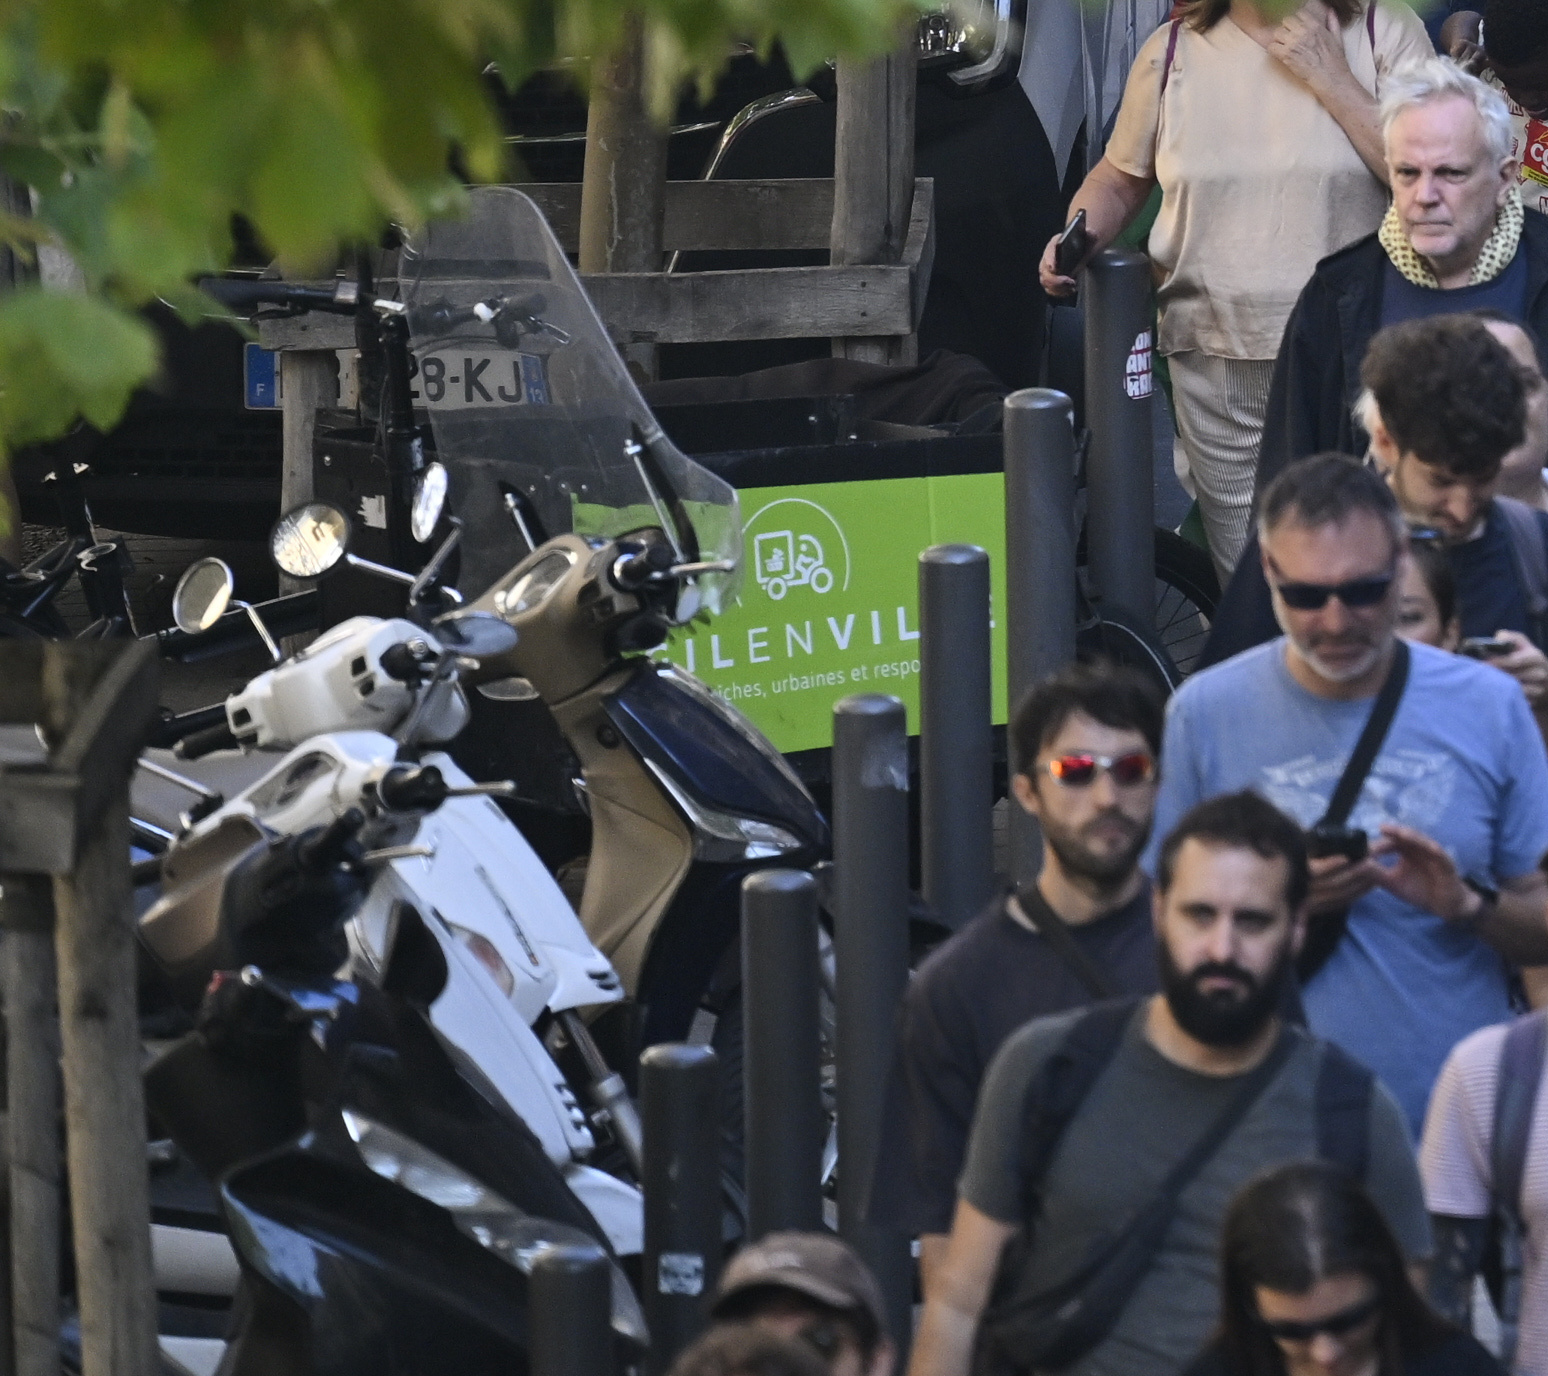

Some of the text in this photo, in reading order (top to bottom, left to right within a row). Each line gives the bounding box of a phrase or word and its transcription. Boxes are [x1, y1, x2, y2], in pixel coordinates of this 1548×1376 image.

[771, 669, 846, 695] urbaines
[850, 664, 869, 682] et
[873, 658, 921, 680] respo
